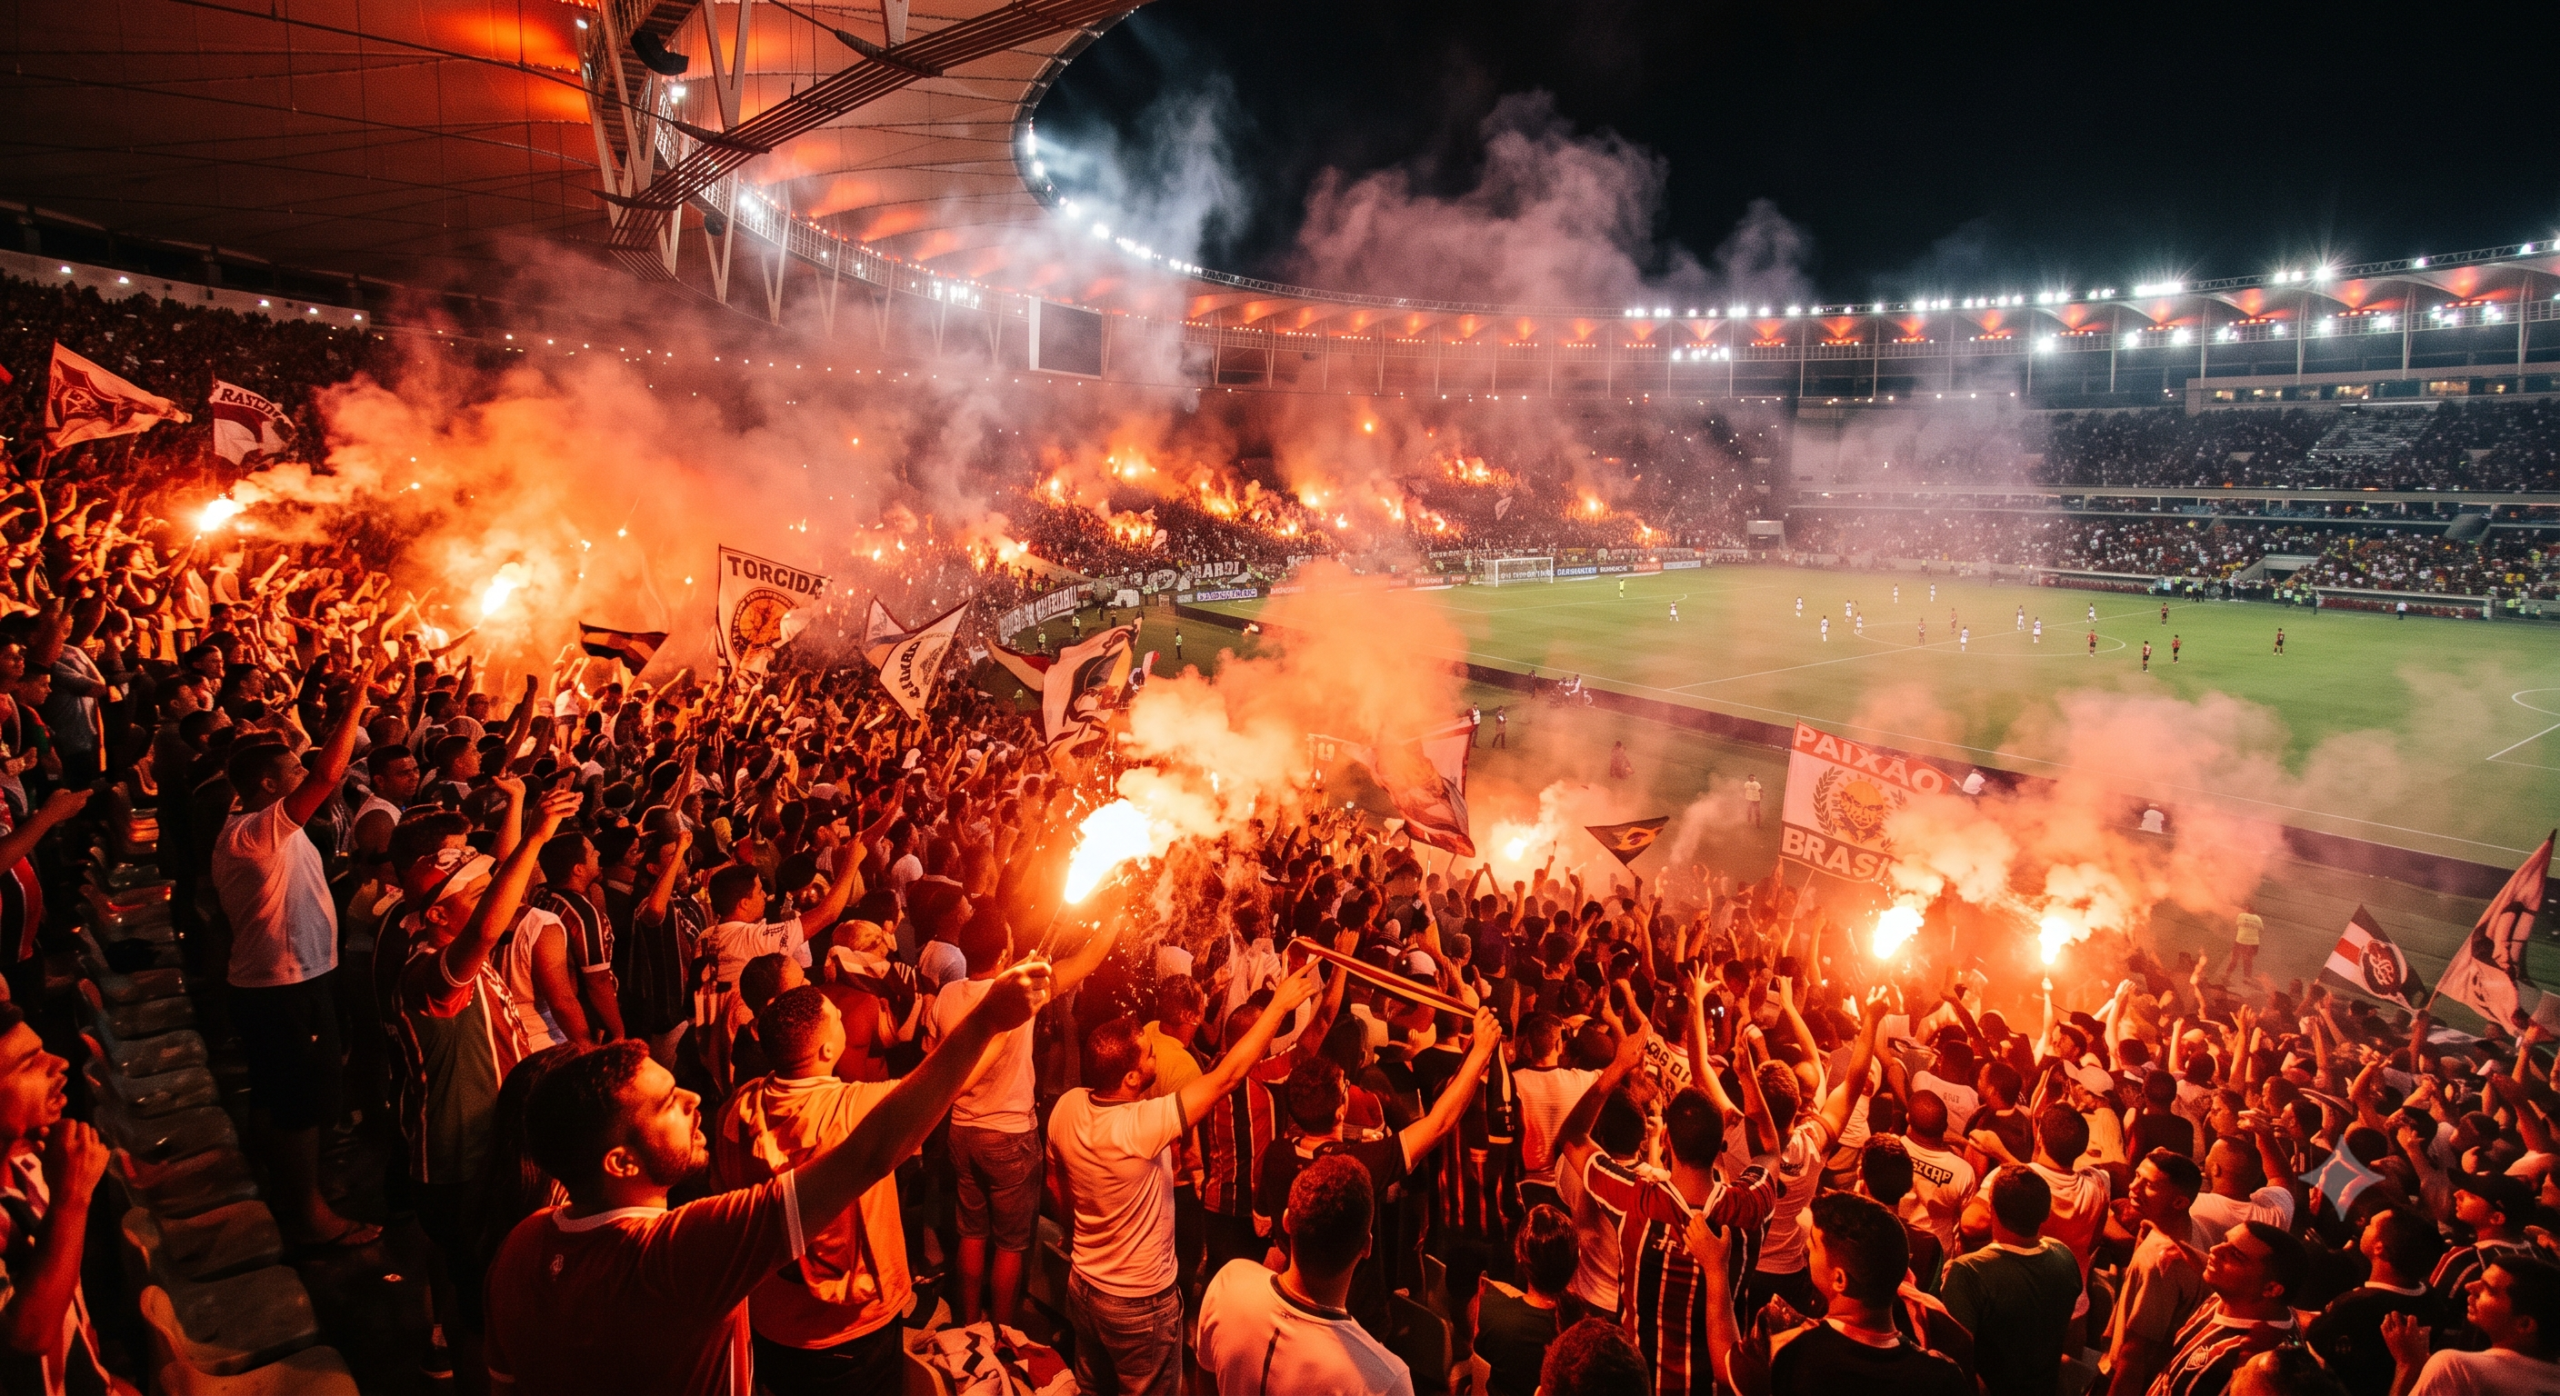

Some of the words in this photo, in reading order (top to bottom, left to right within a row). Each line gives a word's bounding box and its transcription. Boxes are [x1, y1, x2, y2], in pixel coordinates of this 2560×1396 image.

[727, 555, 823, 600] TORCIDA
[1795, 723, 1943, 796] PAIXÃO
[1782, 826, 1890, 882] BRASI
